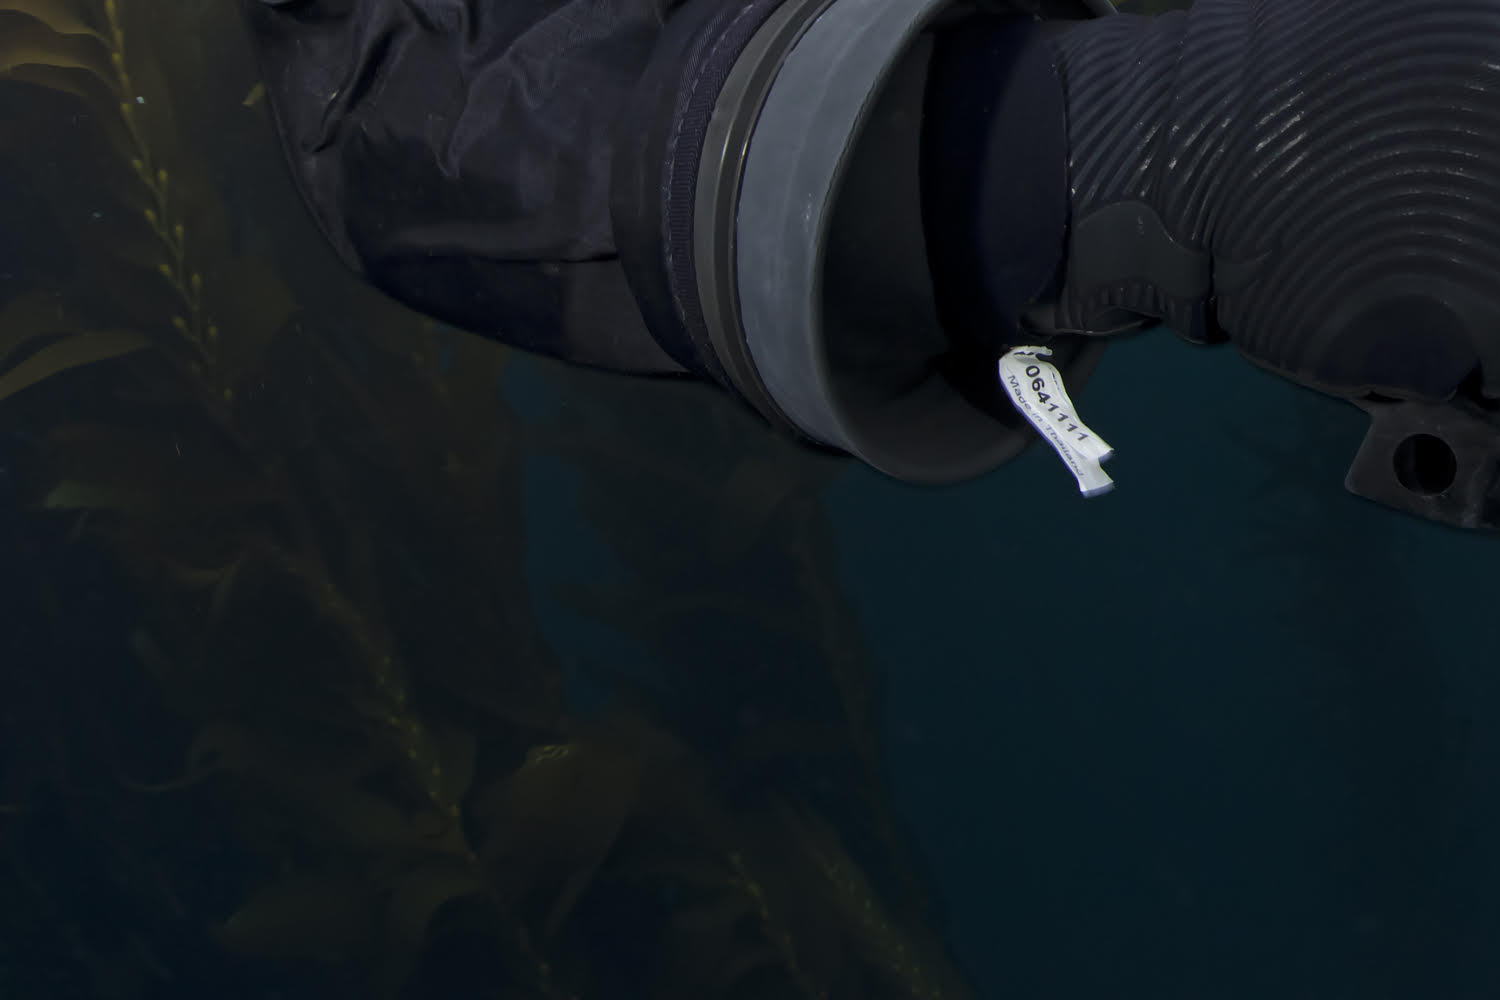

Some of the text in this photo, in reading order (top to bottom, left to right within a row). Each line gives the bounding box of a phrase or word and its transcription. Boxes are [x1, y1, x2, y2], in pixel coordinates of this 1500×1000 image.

[1007, 374, 1085, 477] Made in Thailand
[1025, 365, 1089, 442] 0641111
